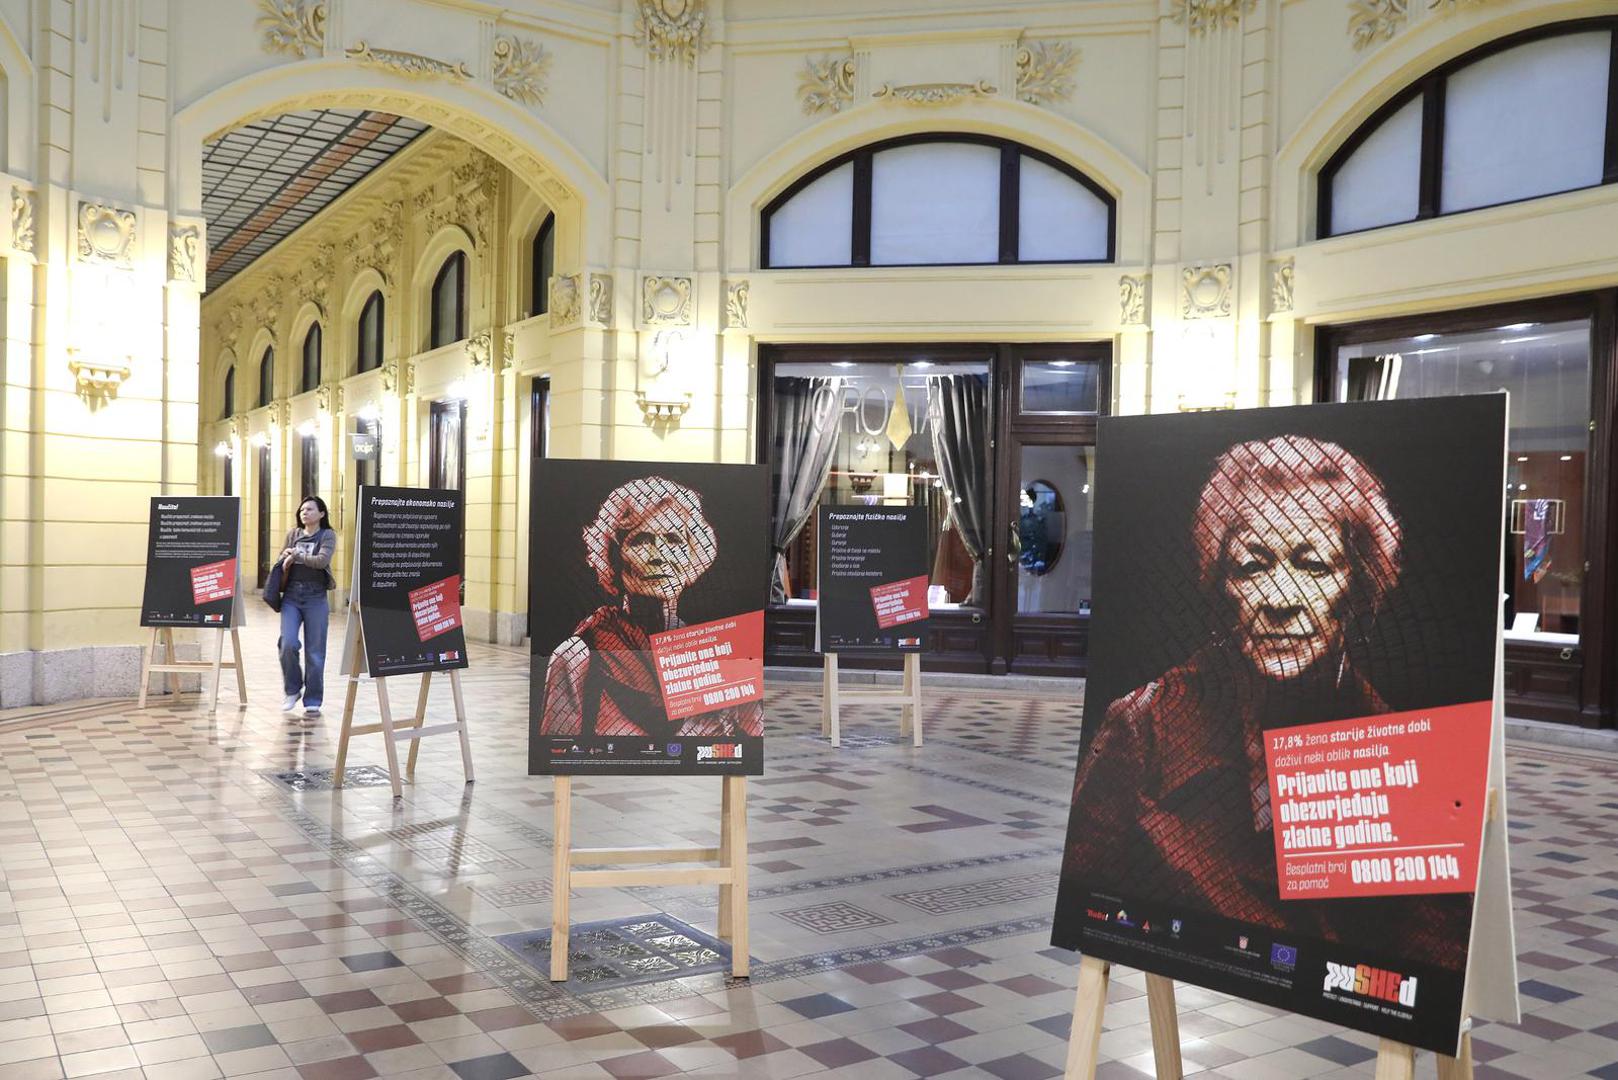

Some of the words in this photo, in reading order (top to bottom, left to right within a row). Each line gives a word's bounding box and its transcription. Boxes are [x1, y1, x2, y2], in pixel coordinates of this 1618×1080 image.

[371, 497, 405, 506] Prepoznajte
[406, 499, 436, 507] ekonomsko
[437, 500, 455, 508] nasilje
[864, 513, 885, 521] fizičko
[686, 629, 704, 638] starije
[725, 621, 736, 629] dobi
[659, 651, 697, 668] Prijavite
[698, 648, 715, 660] one
[715, 642, 732, 656] koji
[665, 679, 692, 695] zlatne
[693, 673, 725, 690] godine.
[703, 691, 725, 705] 0800
[725, 687, 741, 699] 200
[741, 684, 755, 697] 144
[1273, 734, 1302, 750] 17,8%
[1305, 733, 1328, 746] žena
[1330, 727, 1365, 743] starije
[1367, 724, 1405, 738] životne
[1408, 720, 1430, 732] dobi
[1275, 754, 1301, 768] doživi
[1304, 752, 1325, 764] neki
[1327, 748, 1351, 761] oblik
[1276, 768, 1348, 797] Prijavite
[1350, 767, 1382, 789] one
[1384, 760, 1419, 788] koji
[1280, 791, 1389, 823] obezvrjeđuju
[1282, 825, 1332, 849] zlatne
[1334, 820, 1398, 849] godine.
[1285, 862, 1326, 876] Besplatni
[1328, 861, 1347, 874] broj
[1351, 858, 1392, 883] 0800
[1394, 856, 1426, 881] 200
[1428, 854, 1459, 880] 144
[1286, 880, 1298, 889] za
[1299, 877, 1329, 891] pomoć
[1323, 960, 1417, 1008] puSHEd
